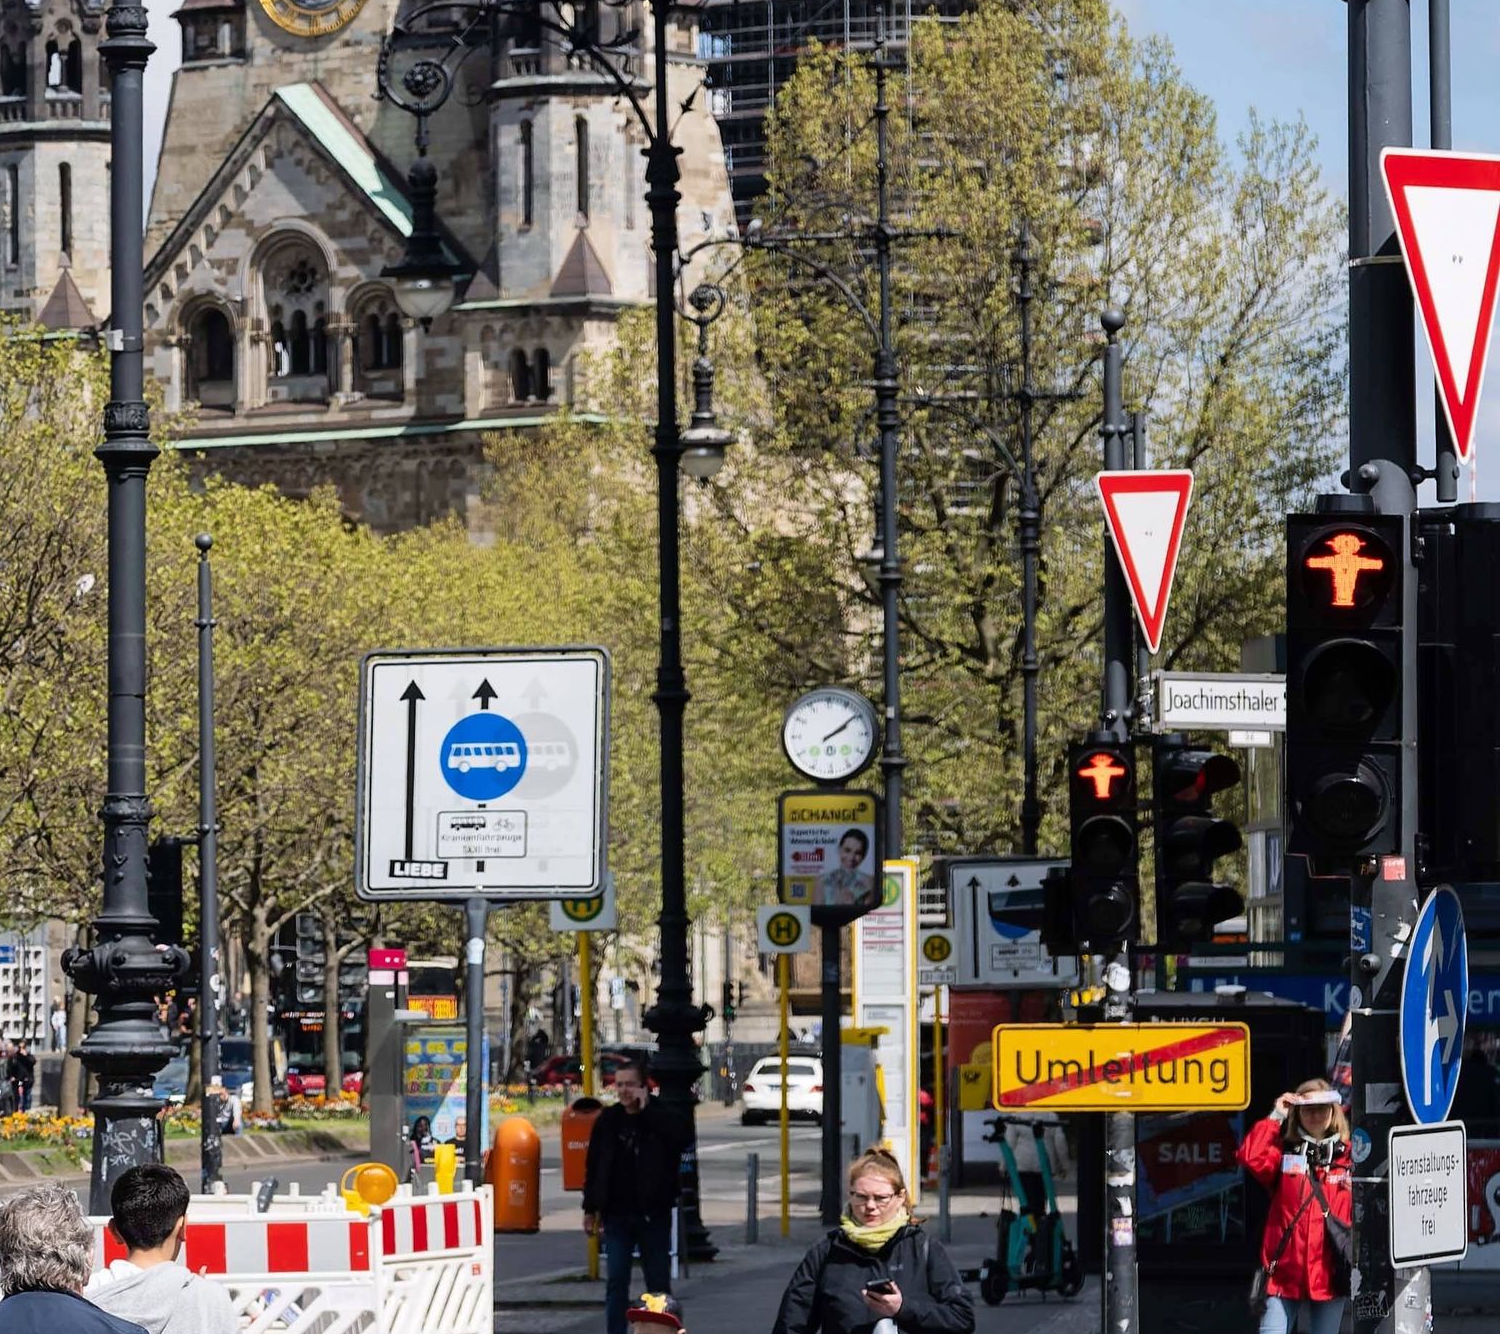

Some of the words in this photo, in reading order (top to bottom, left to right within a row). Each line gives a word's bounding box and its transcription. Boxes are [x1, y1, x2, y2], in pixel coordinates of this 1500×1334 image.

[1164, 687, 1279, 713] Joachimsthaler
[392, 862, 445, 878] LIEBE
[1015, 1049, 1230, 1094] Umleitung
[1158, 1142, 1223, 1164] SALE
[1396, 1152, 1460, 1176] Veranstaltungs-
[1408, 1184, 1448, 1208] fahrzeuge
[1421, 1214, 1437, 1236] frei
